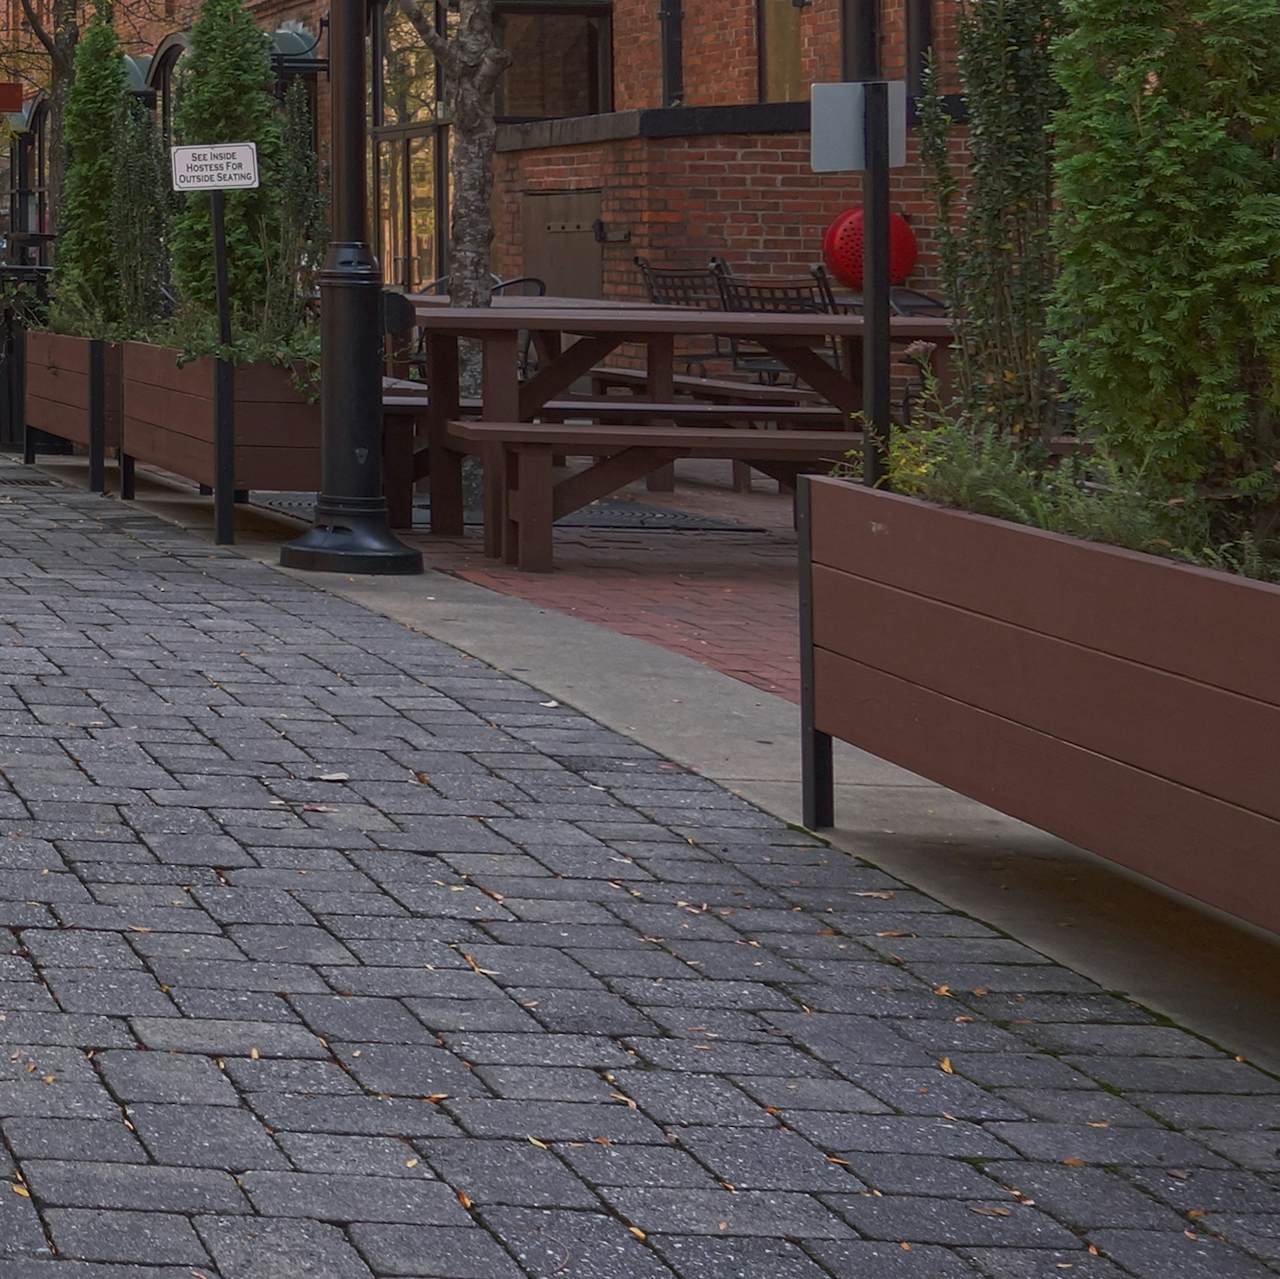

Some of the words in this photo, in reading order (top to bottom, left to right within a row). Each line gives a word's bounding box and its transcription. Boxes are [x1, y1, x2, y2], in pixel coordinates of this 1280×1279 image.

[191, 152, 208, 162] SEE
[210, 151, 237, 161] INSIDE
[186, 163, 224, 173] HOSTESS
[226, 161, 243, 170] FOR
[179, 174, 215, 183] OUTSIDE
[217, 172, 252, 182] SEATING
